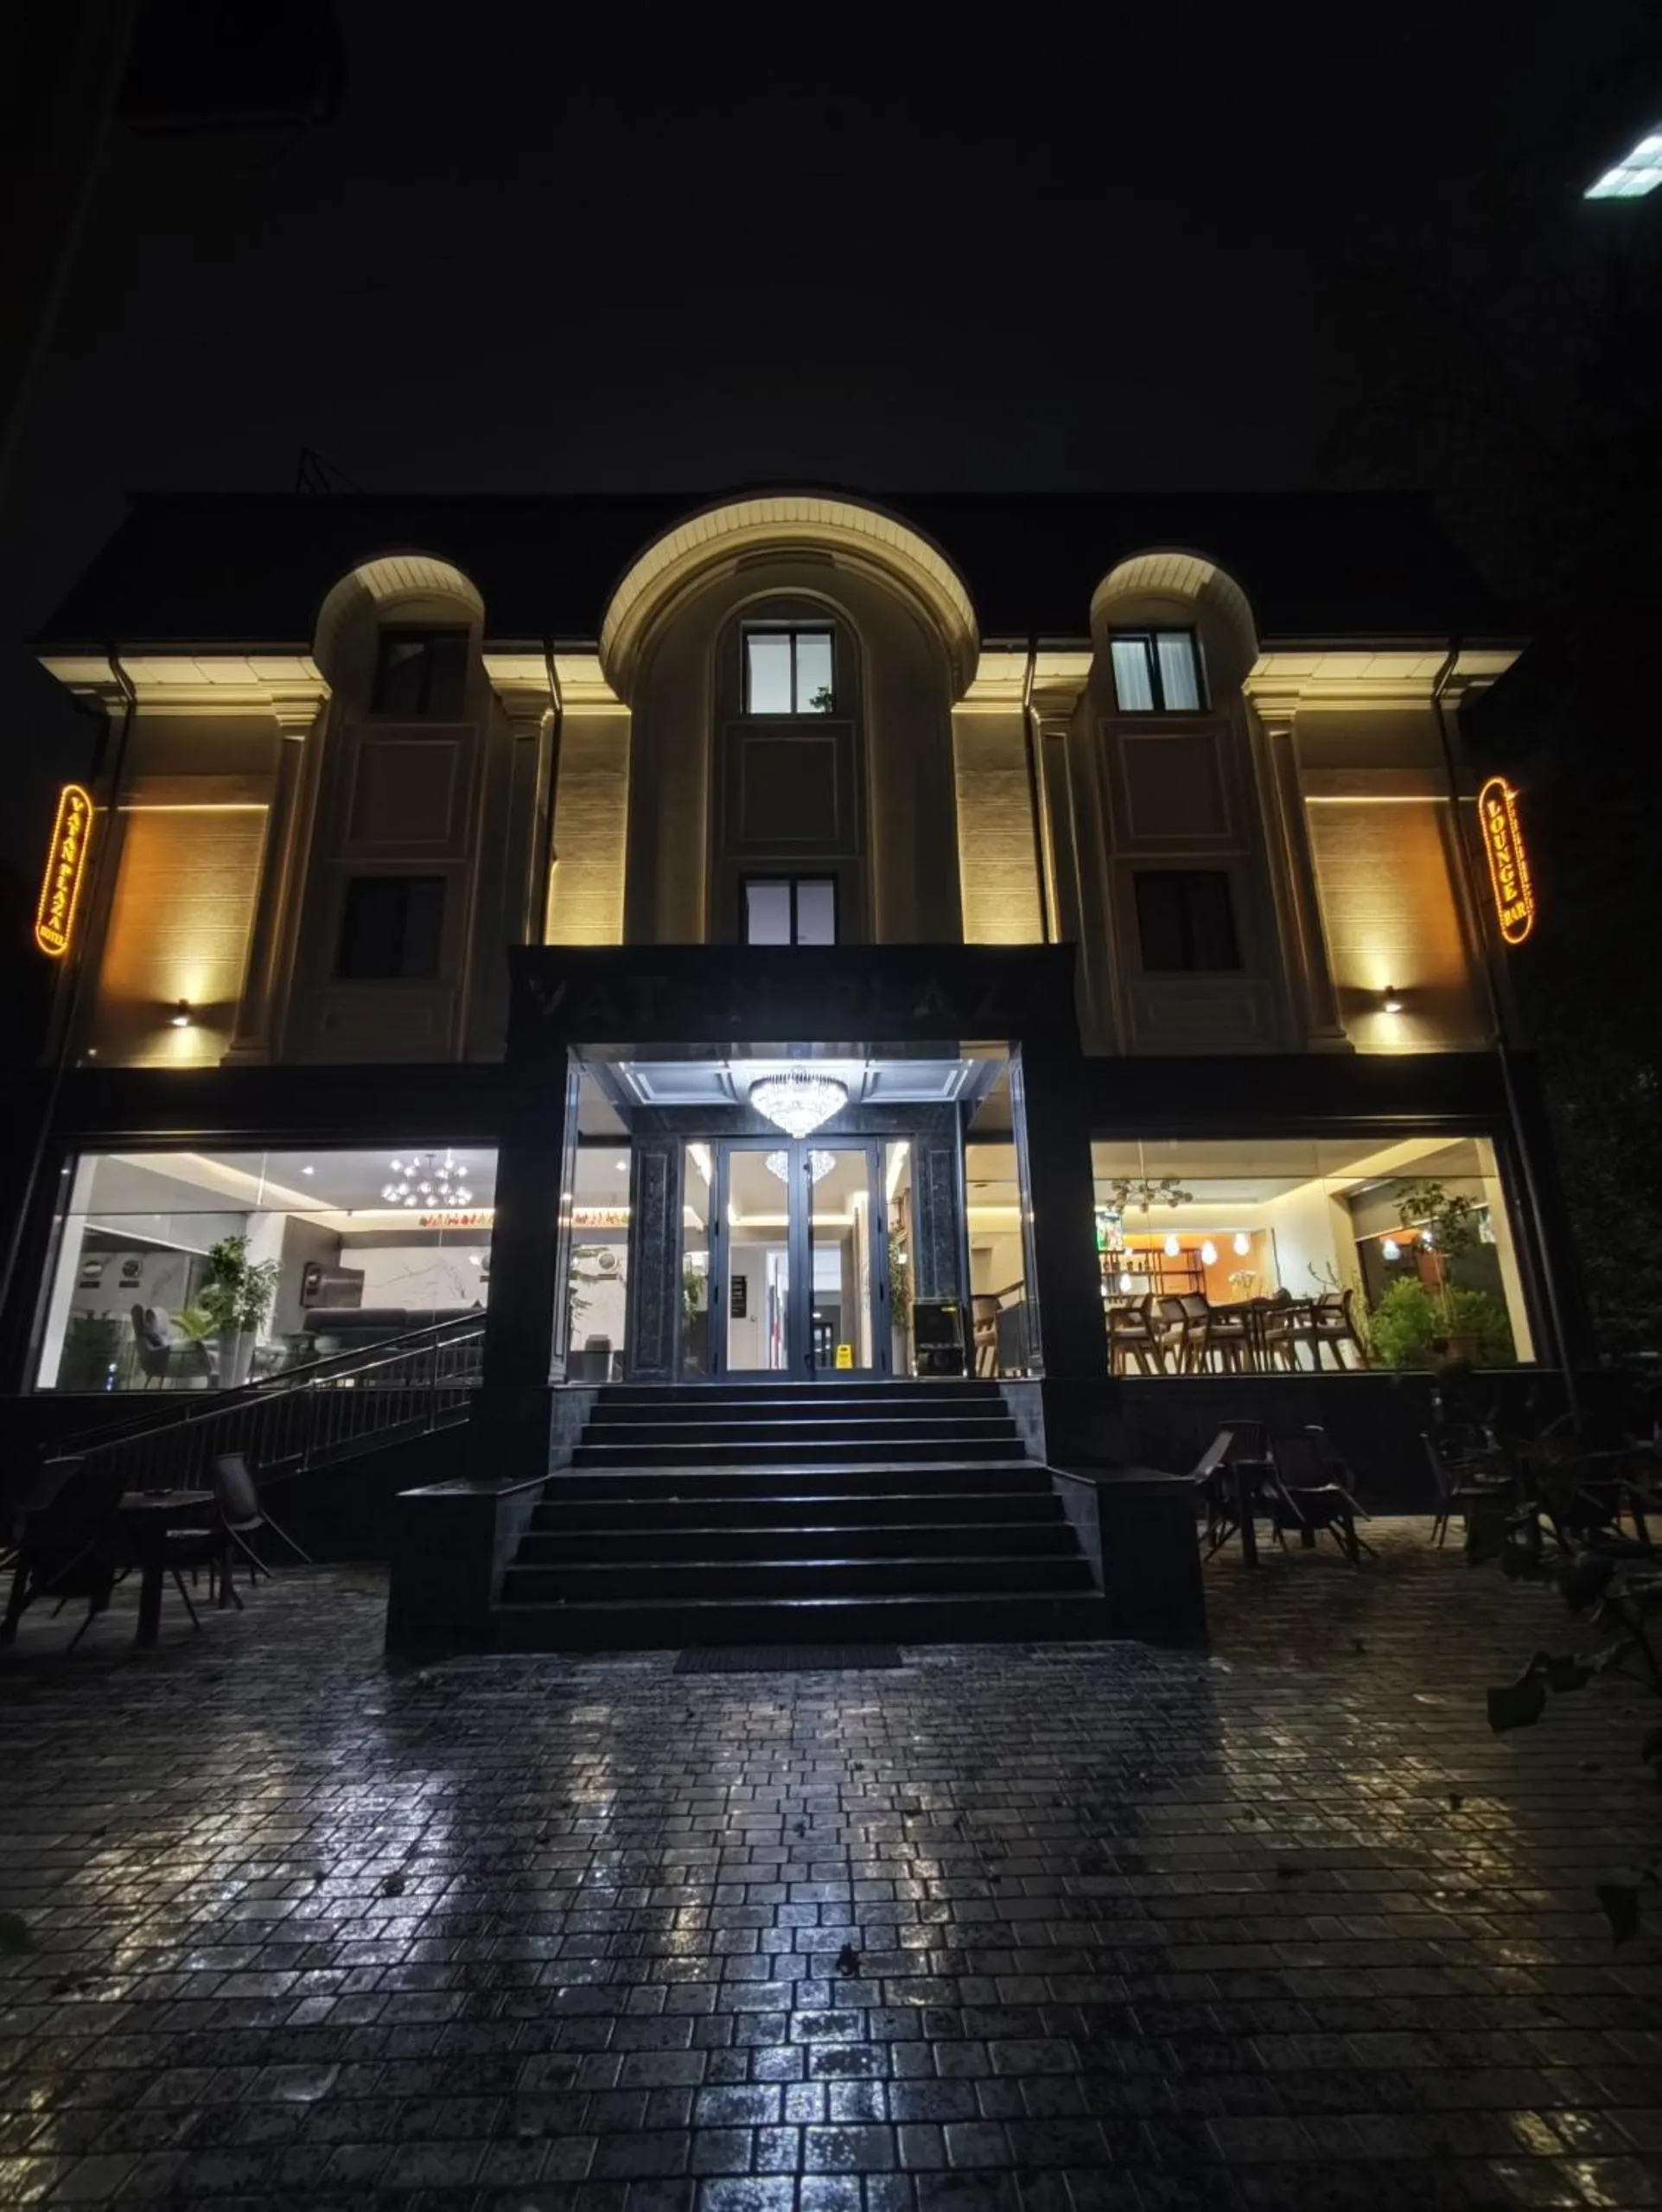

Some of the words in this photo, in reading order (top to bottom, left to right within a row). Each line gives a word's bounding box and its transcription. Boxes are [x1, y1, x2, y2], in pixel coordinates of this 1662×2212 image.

[61, 796, 84, 863] VATAN
[1487, 800, 1518, 902] LOUNGE
[48, 863, 73, 931] PLAZA
[1503, 901, 1526, 928] BAR
[40, 924, 64, 946] HOTEL
